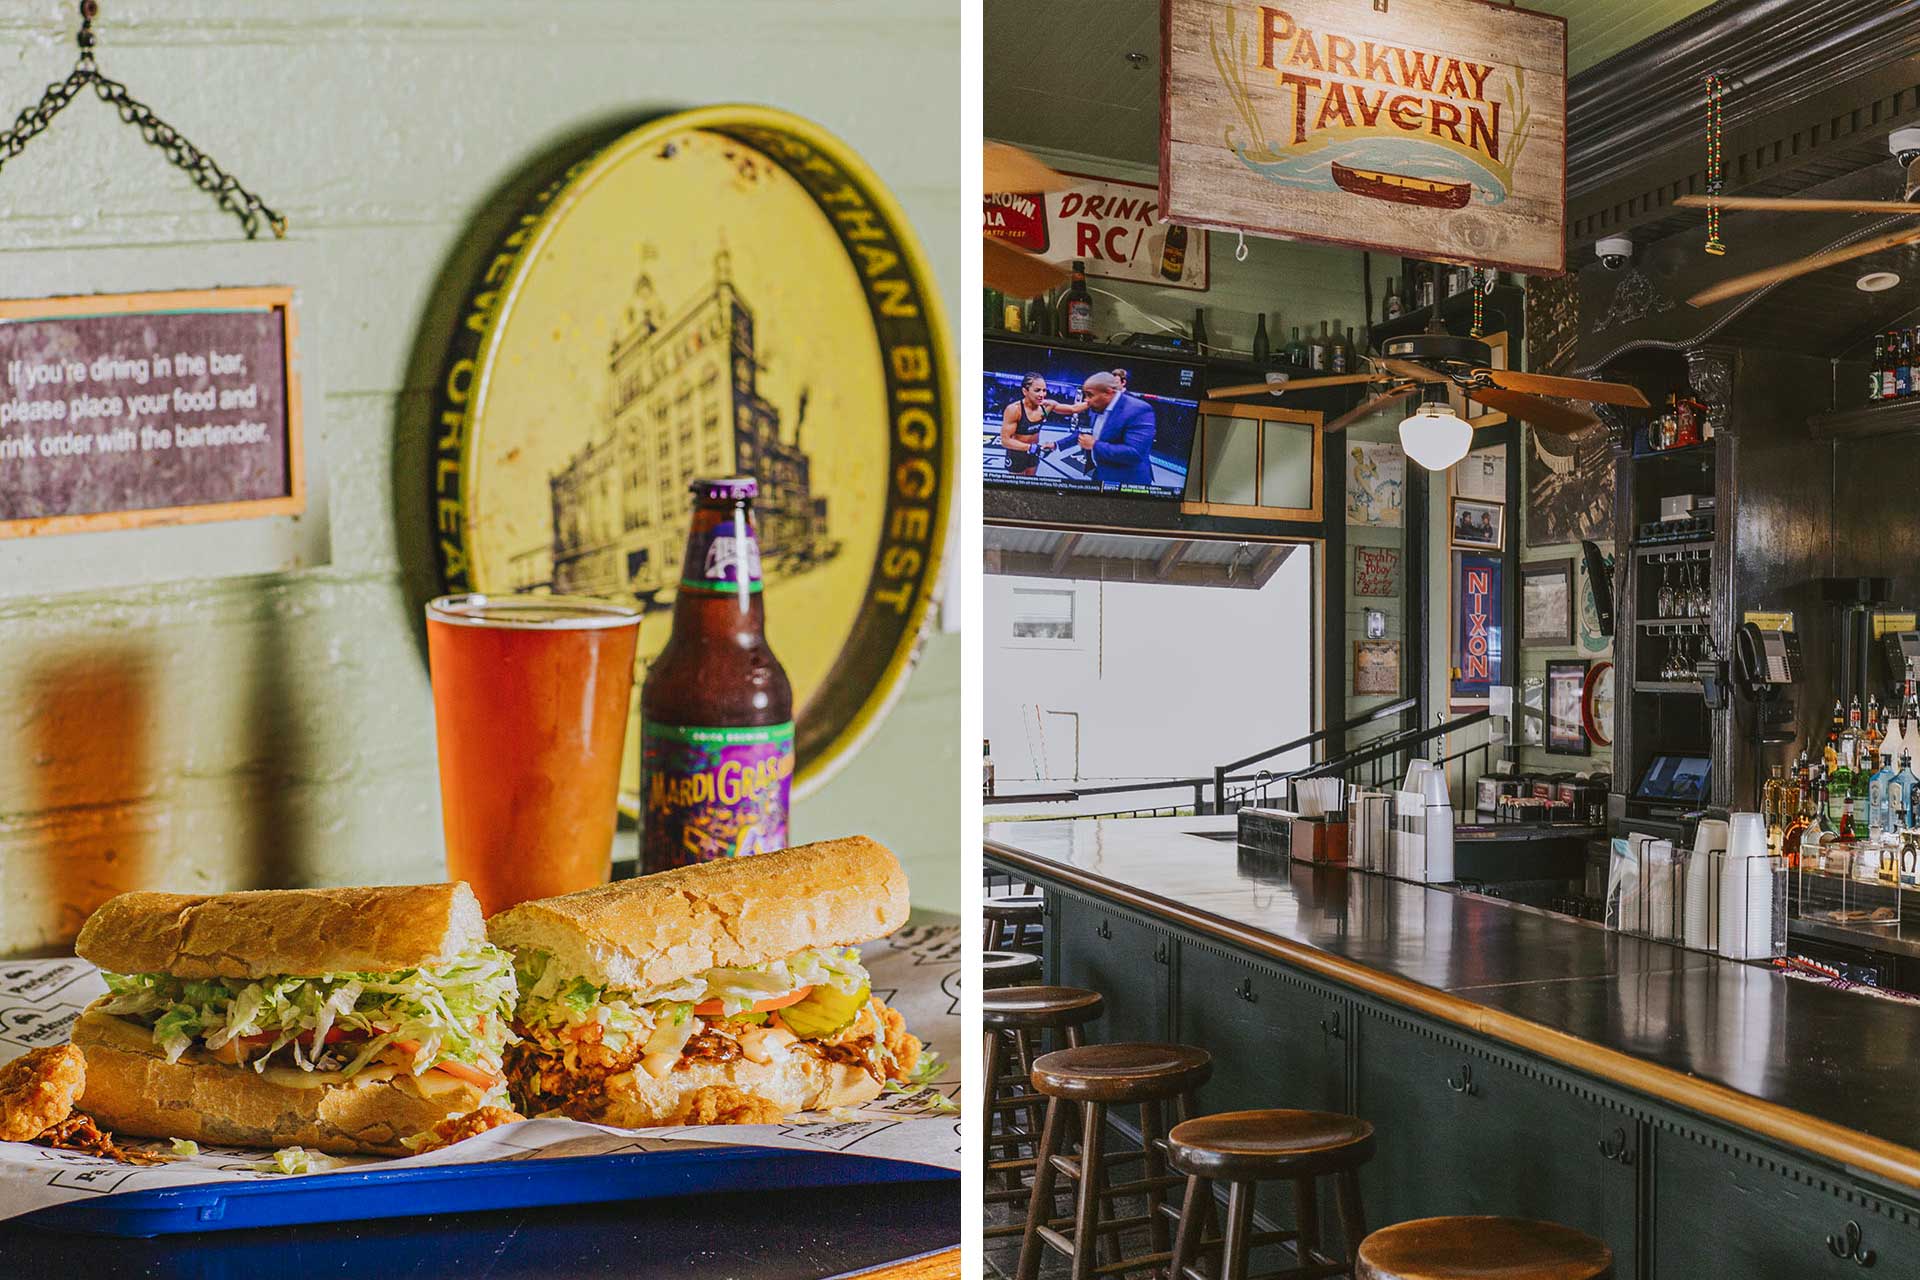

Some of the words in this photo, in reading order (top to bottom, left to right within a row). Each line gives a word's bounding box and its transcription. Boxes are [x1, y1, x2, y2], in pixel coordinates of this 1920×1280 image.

[1258, 5, 1495, 101] PARKWAY
[1277, 72, 1502, 162] TAVERN
[1058, 192, 1159, 227] DRINK
[1076, 221, 1145, 269] RC!
[8, 360, 22, 386] If
[24, 358, 88, 391] you're
[90, 354, 150, 385] dining
[153, 353, 172, 378] in
[175, 352, 207, 377] the
[0, 397, 67, 428] please
[70, 393, 124, 424] place
[126, 394, 170, 421] your
[174, 387, 217, 413] food
[220, 383, 257, 410] and
[437, 358, 475, 592] ORLEA
[823, 184, 919, 318] THAN
[873, 345, 939, 614] BIGGEST
[41, 430, 94, 457] order
[97, 427, 138, 453] with
[141, 424, 172, 451] the
[175, 420, 271, 449] bartender.
[1468, 571, 1488, 678] NIXON
